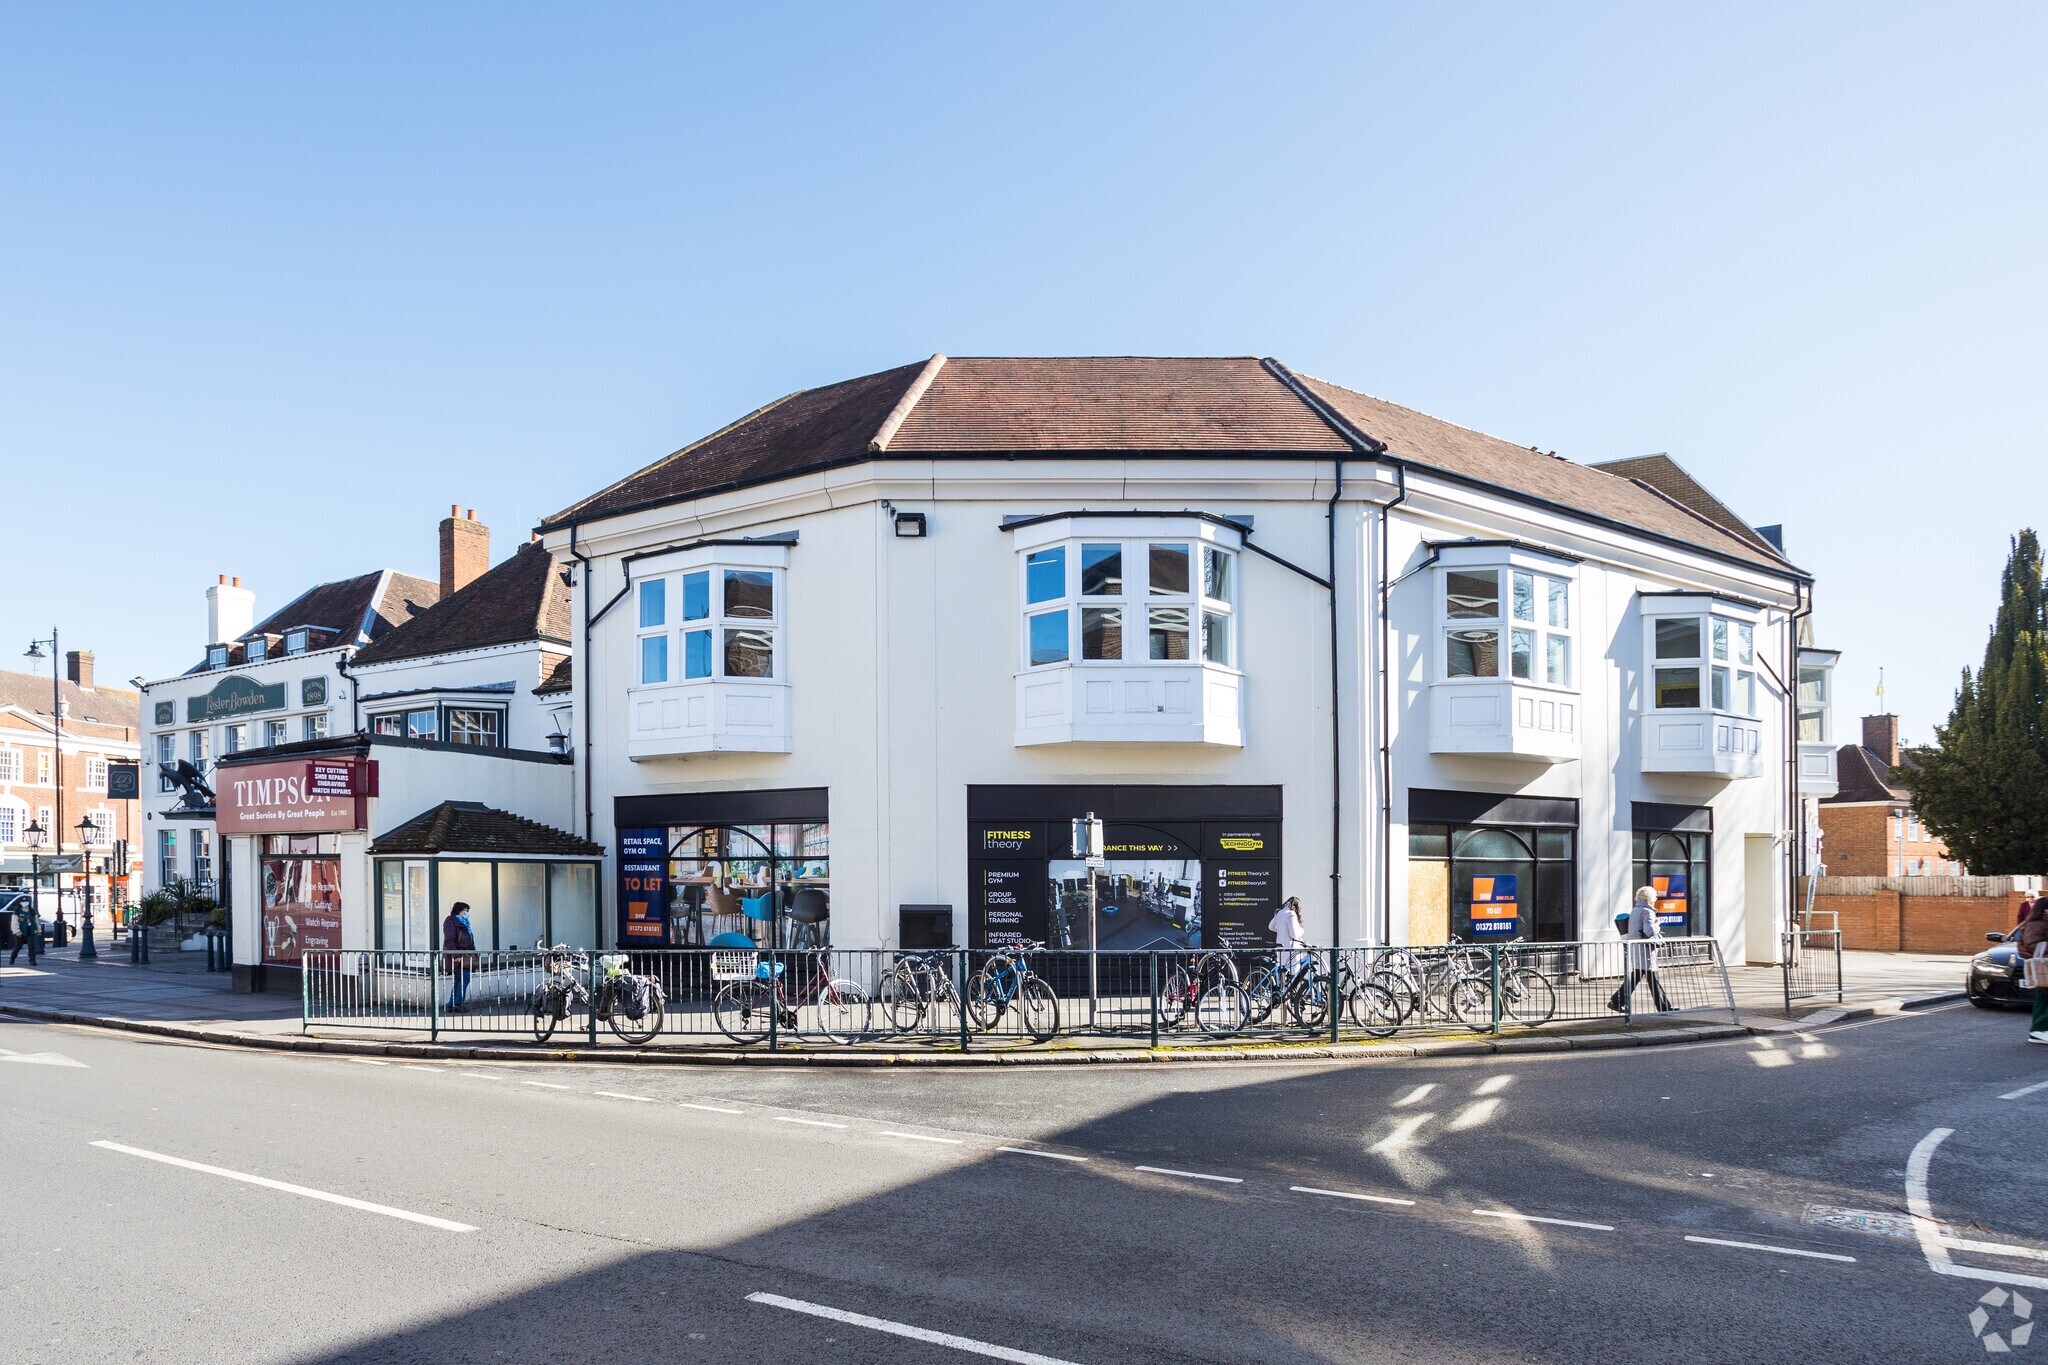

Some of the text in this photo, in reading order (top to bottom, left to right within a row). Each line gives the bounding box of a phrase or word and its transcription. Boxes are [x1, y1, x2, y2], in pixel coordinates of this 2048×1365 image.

[206, 689, 266, 714] Lester Bowden
[307, 691, 322, 702] 1898
[234, 776, 330, 806] TIMPSO
[240, 808, 326, 820] Great Service By Great People
[987, 831, 1031, 839] FITNESS
[643, 838, 662, 846] SPACE,
[988, 840, 1022, 850] theory
[318, 883, 336, 893] Repairs
[624, 878, 662, 891] TO LET
[314, 900, 333, 912] Cutting
[305, 918, 339, 930] Watch Repairs
[305, 936, 328, 948] Engraving
